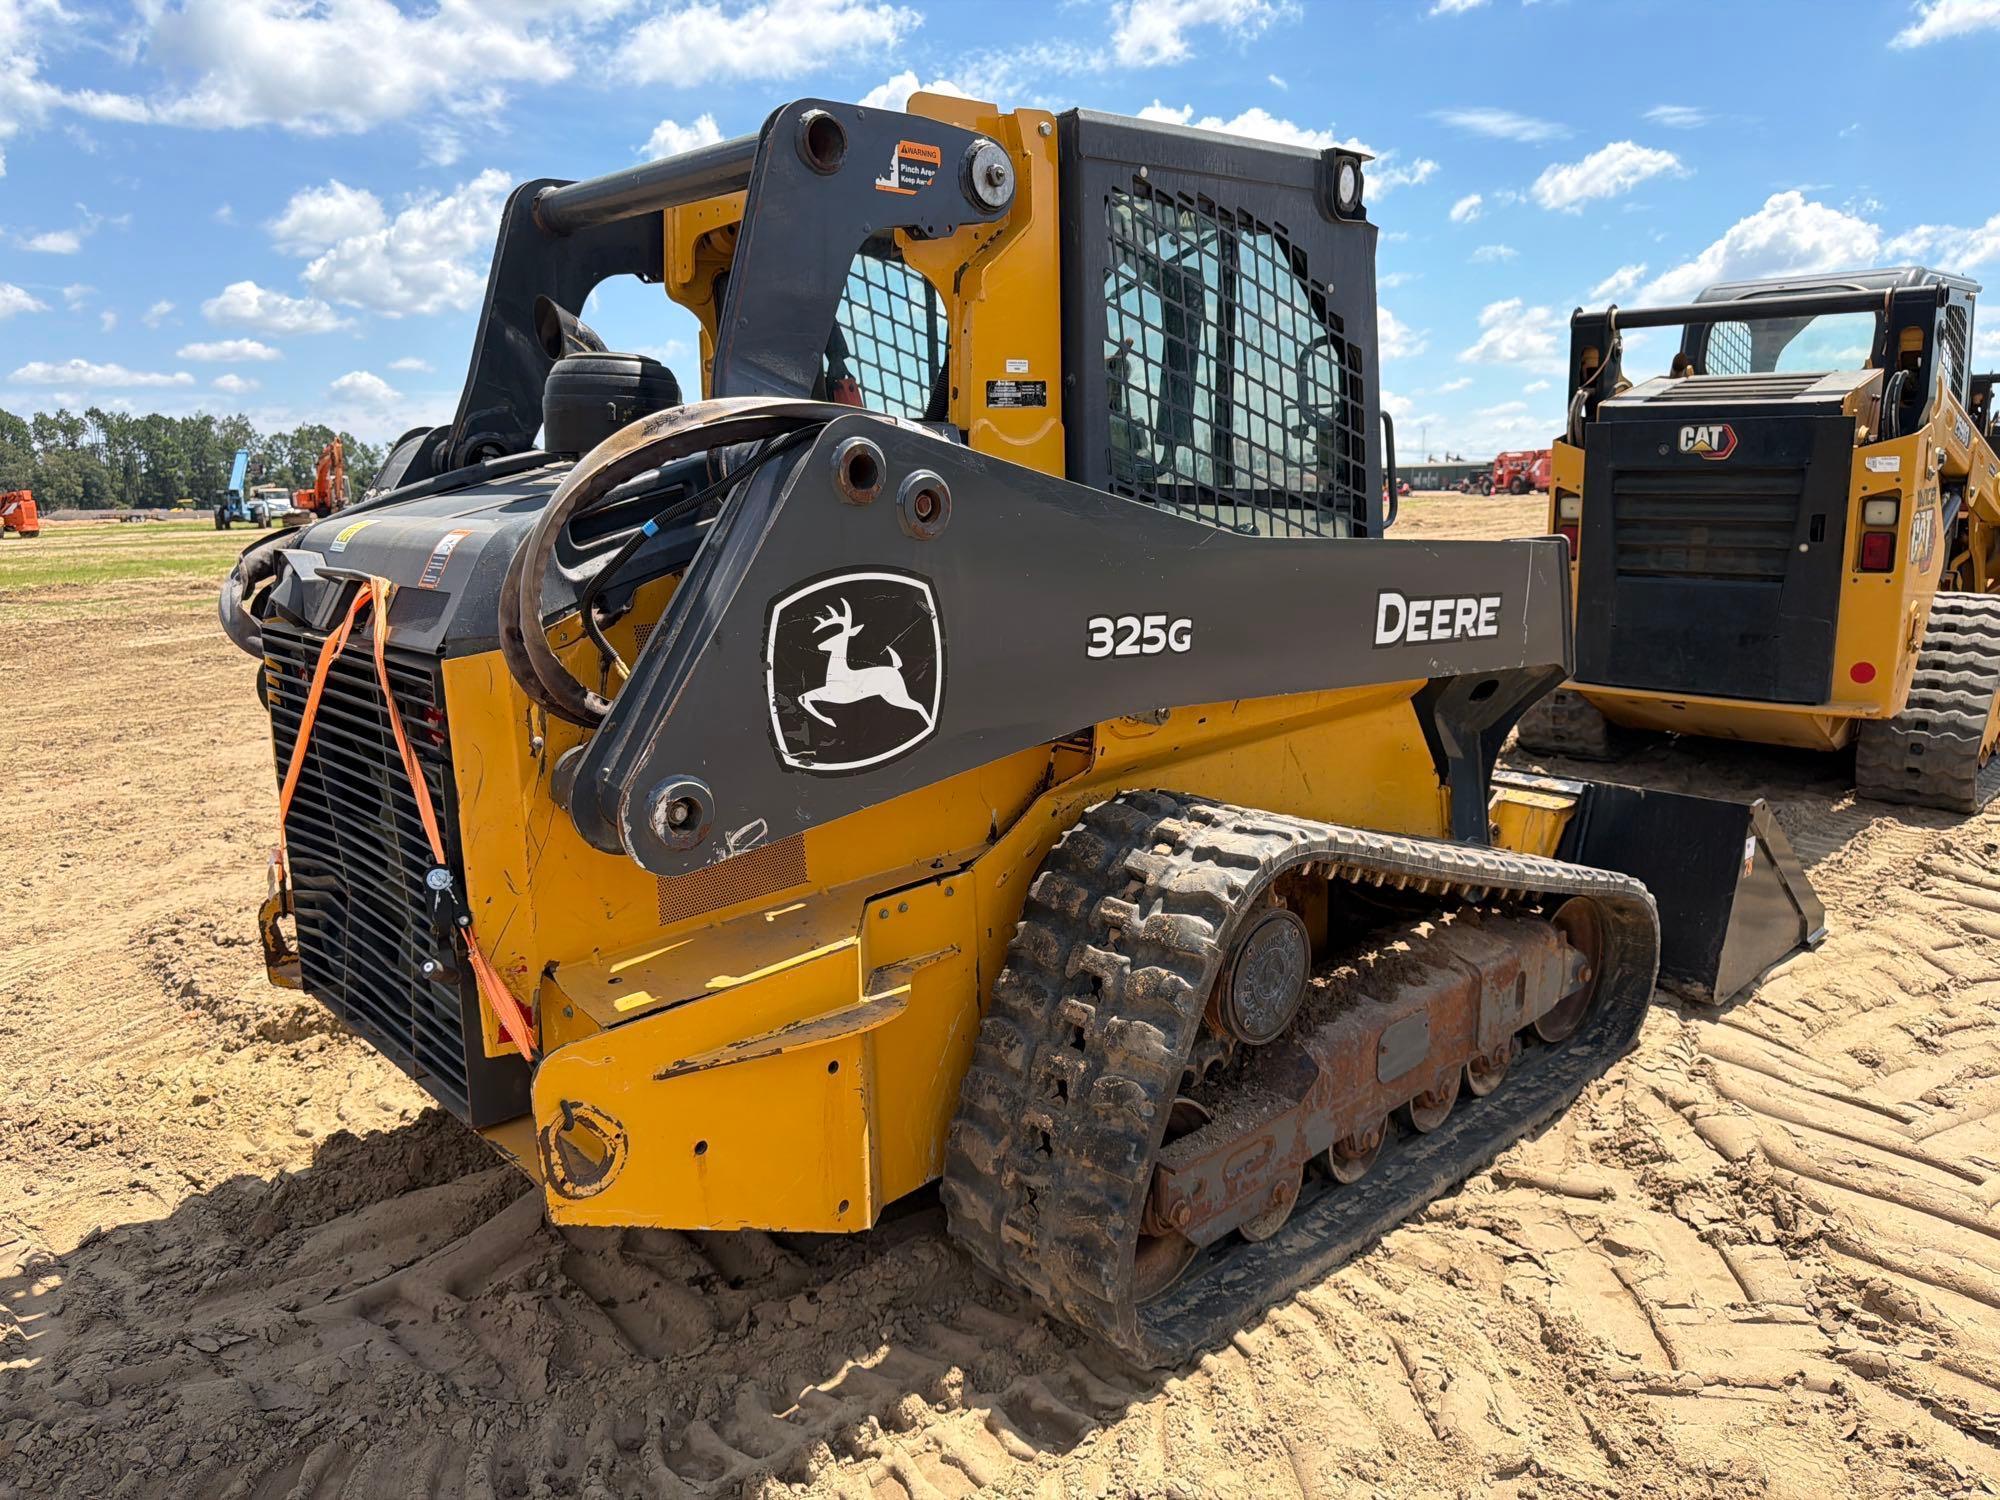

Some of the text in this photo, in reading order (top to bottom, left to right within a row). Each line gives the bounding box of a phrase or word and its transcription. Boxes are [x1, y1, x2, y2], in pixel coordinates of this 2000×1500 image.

[907, 146, 937, 159] WARNING
[900, 163, 920, 175] Pinch
[900, 175, 916, 186] Keep
[1680, 426, 1723, 452] CAT
[1909, 508, 1935, 562] CAT
[1375, 592, 1501, 645] DEERE
[1087, 615, 1193, 658] 325G
